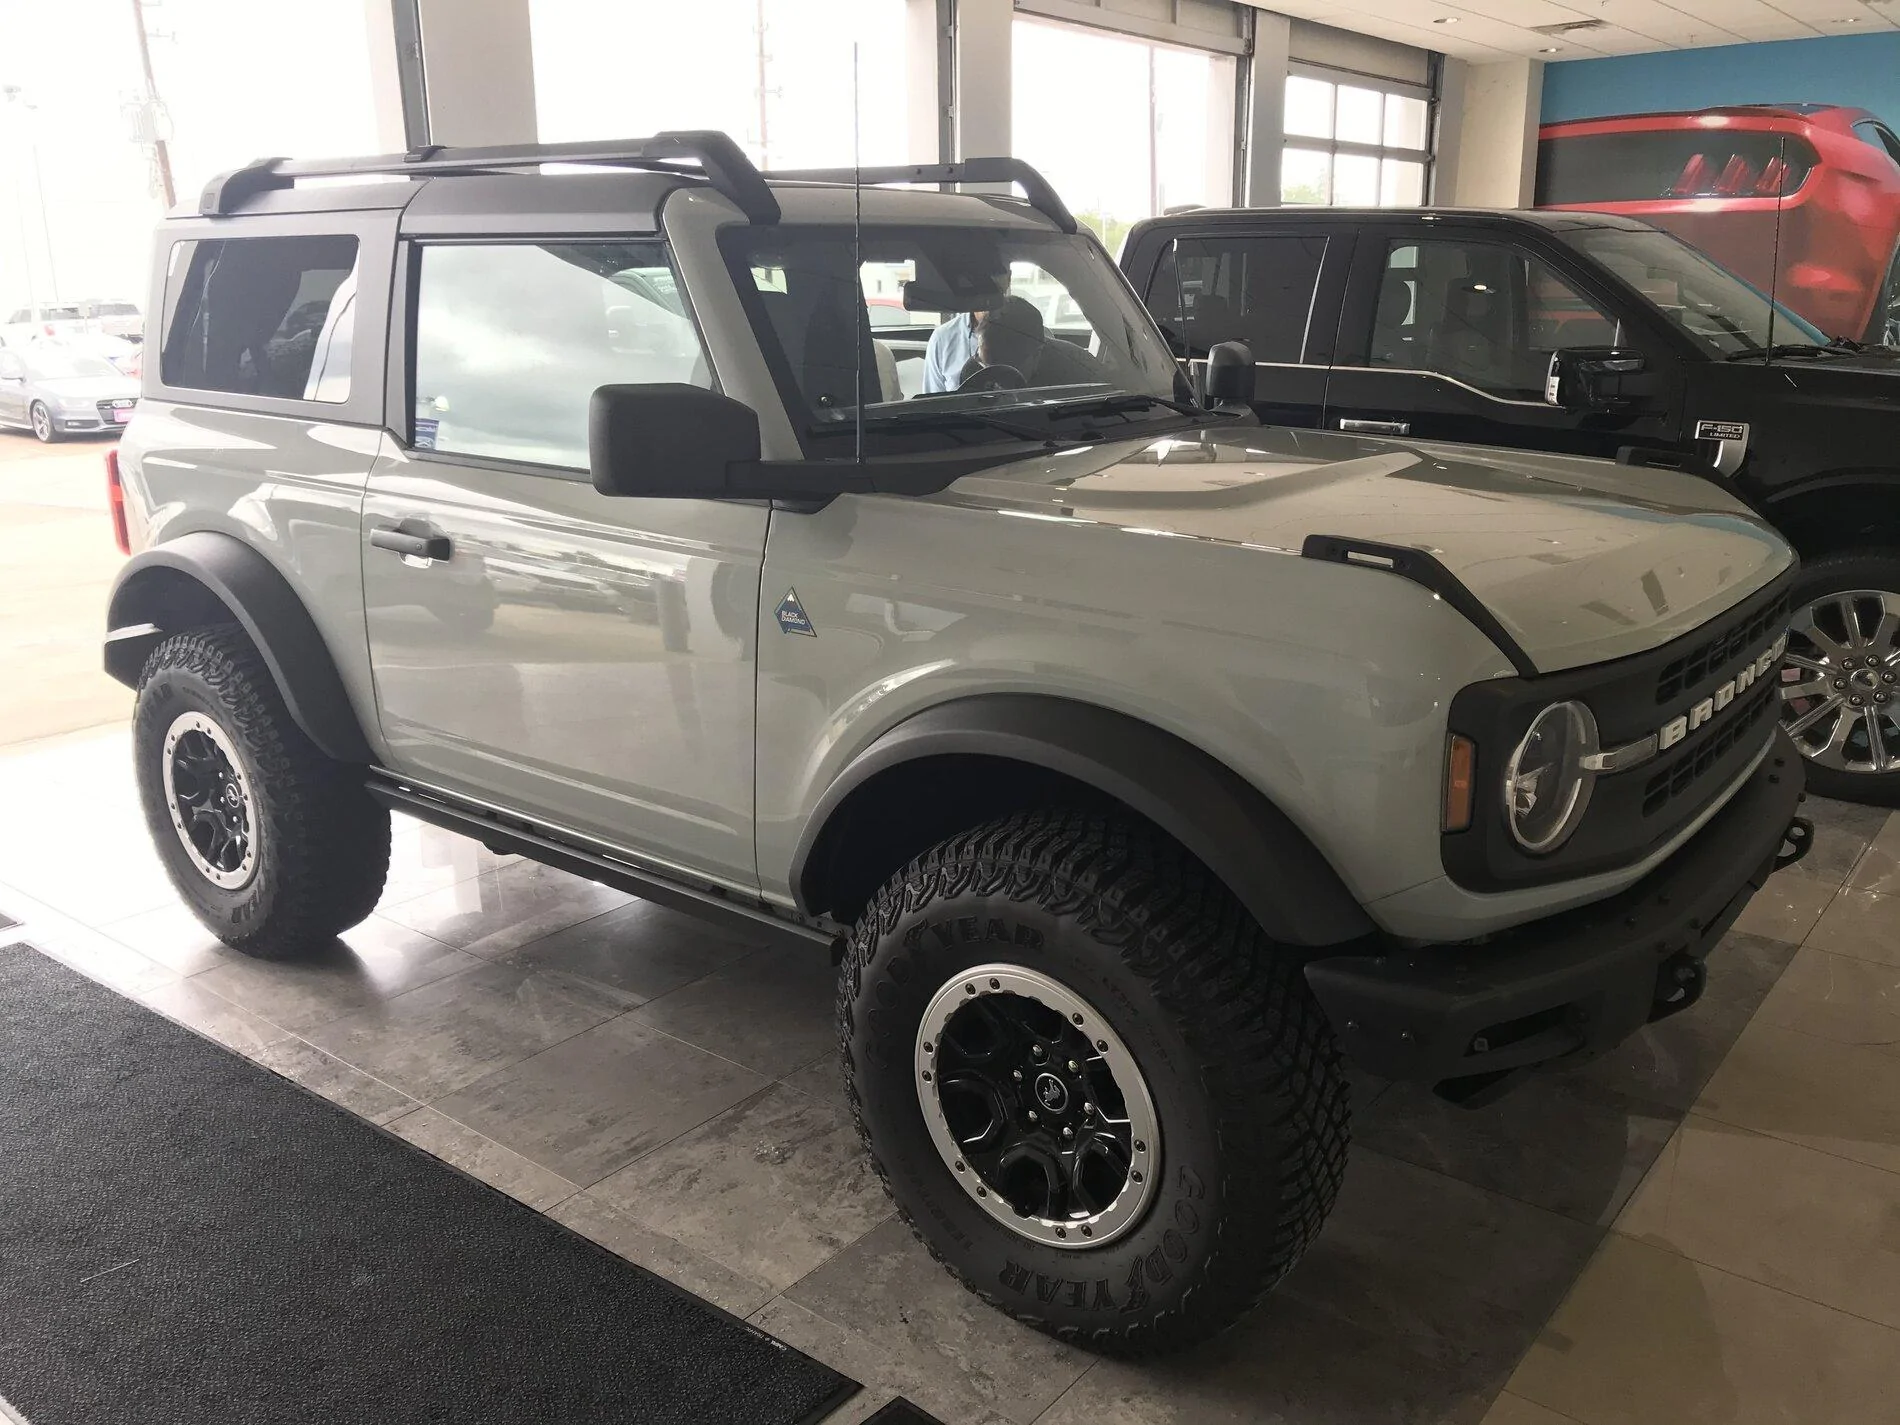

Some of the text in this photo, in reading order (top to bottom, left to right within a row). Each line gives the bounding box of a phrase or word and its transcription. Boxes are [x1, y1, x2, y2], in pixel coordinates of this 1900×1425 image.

[1701, 423, 1744, 434] F-150
[1709, 431, 1741, 439] LIMITED
[1658, 634, 1788, 750] BRONCO
